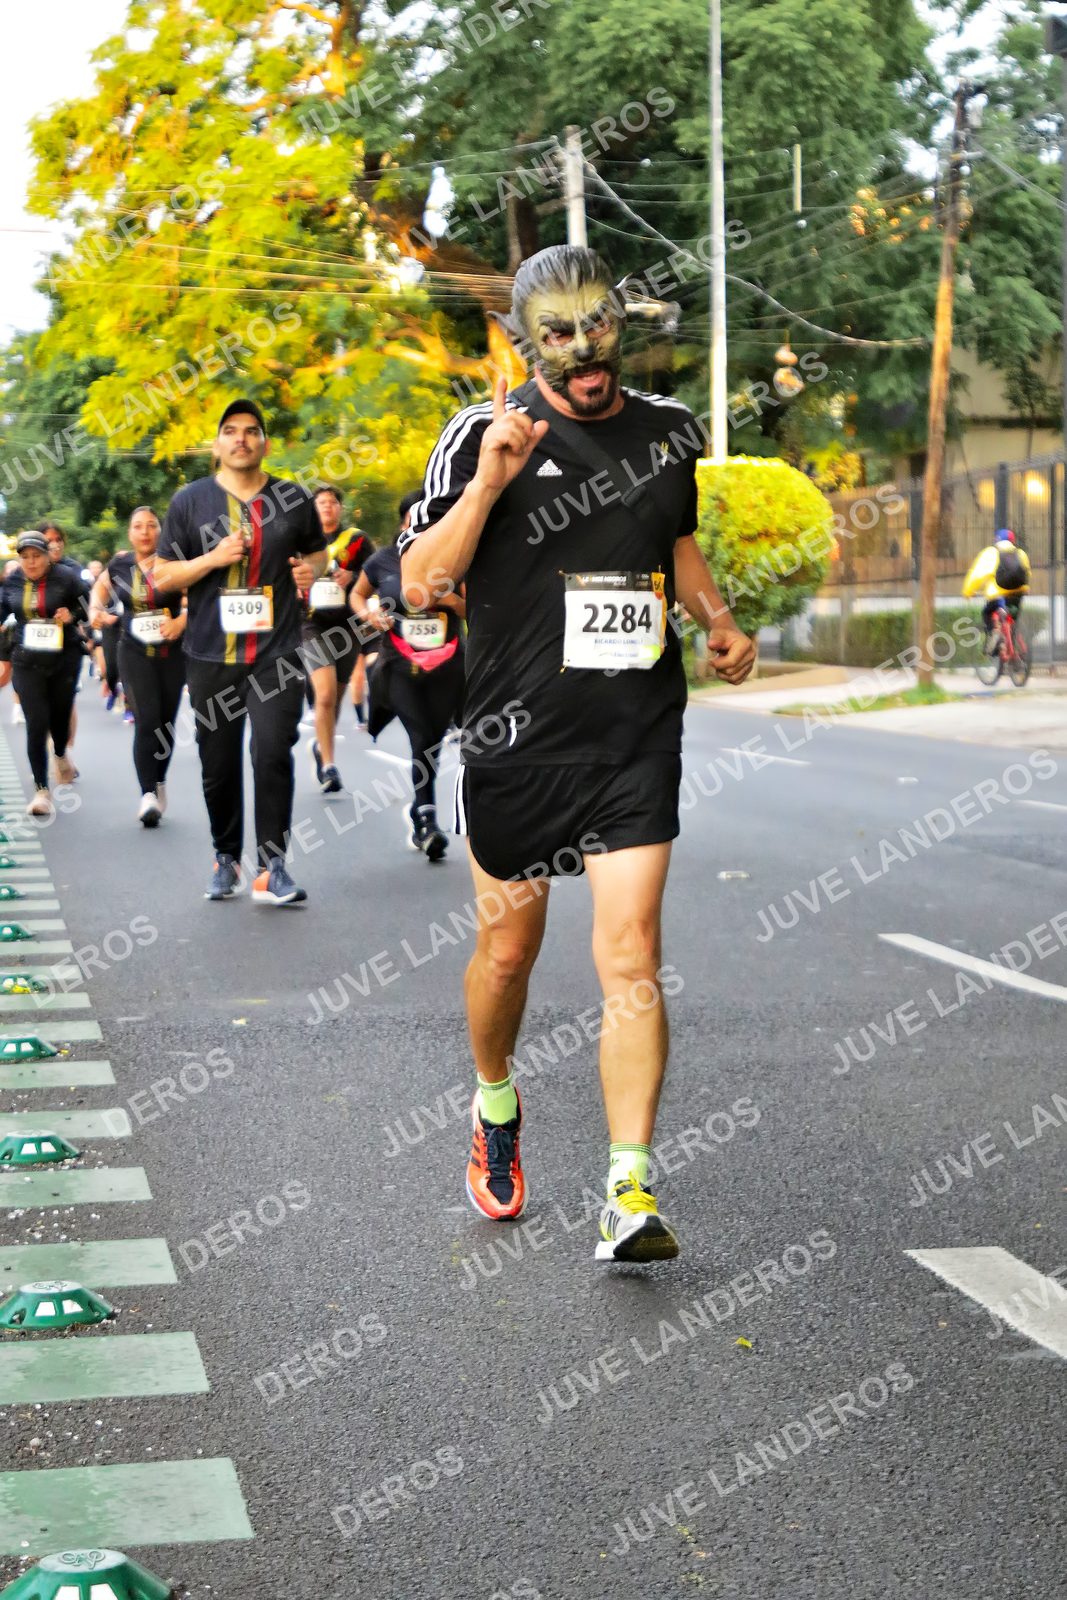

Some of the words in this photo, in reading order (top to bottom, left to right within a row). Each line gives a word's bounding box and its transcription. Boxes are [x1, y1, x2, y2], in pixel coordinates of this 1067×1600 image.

[227, 600, 263, 616] 4309
[582, 603, 652, 633] 2284
[409, 623, 438, 635] 7558
